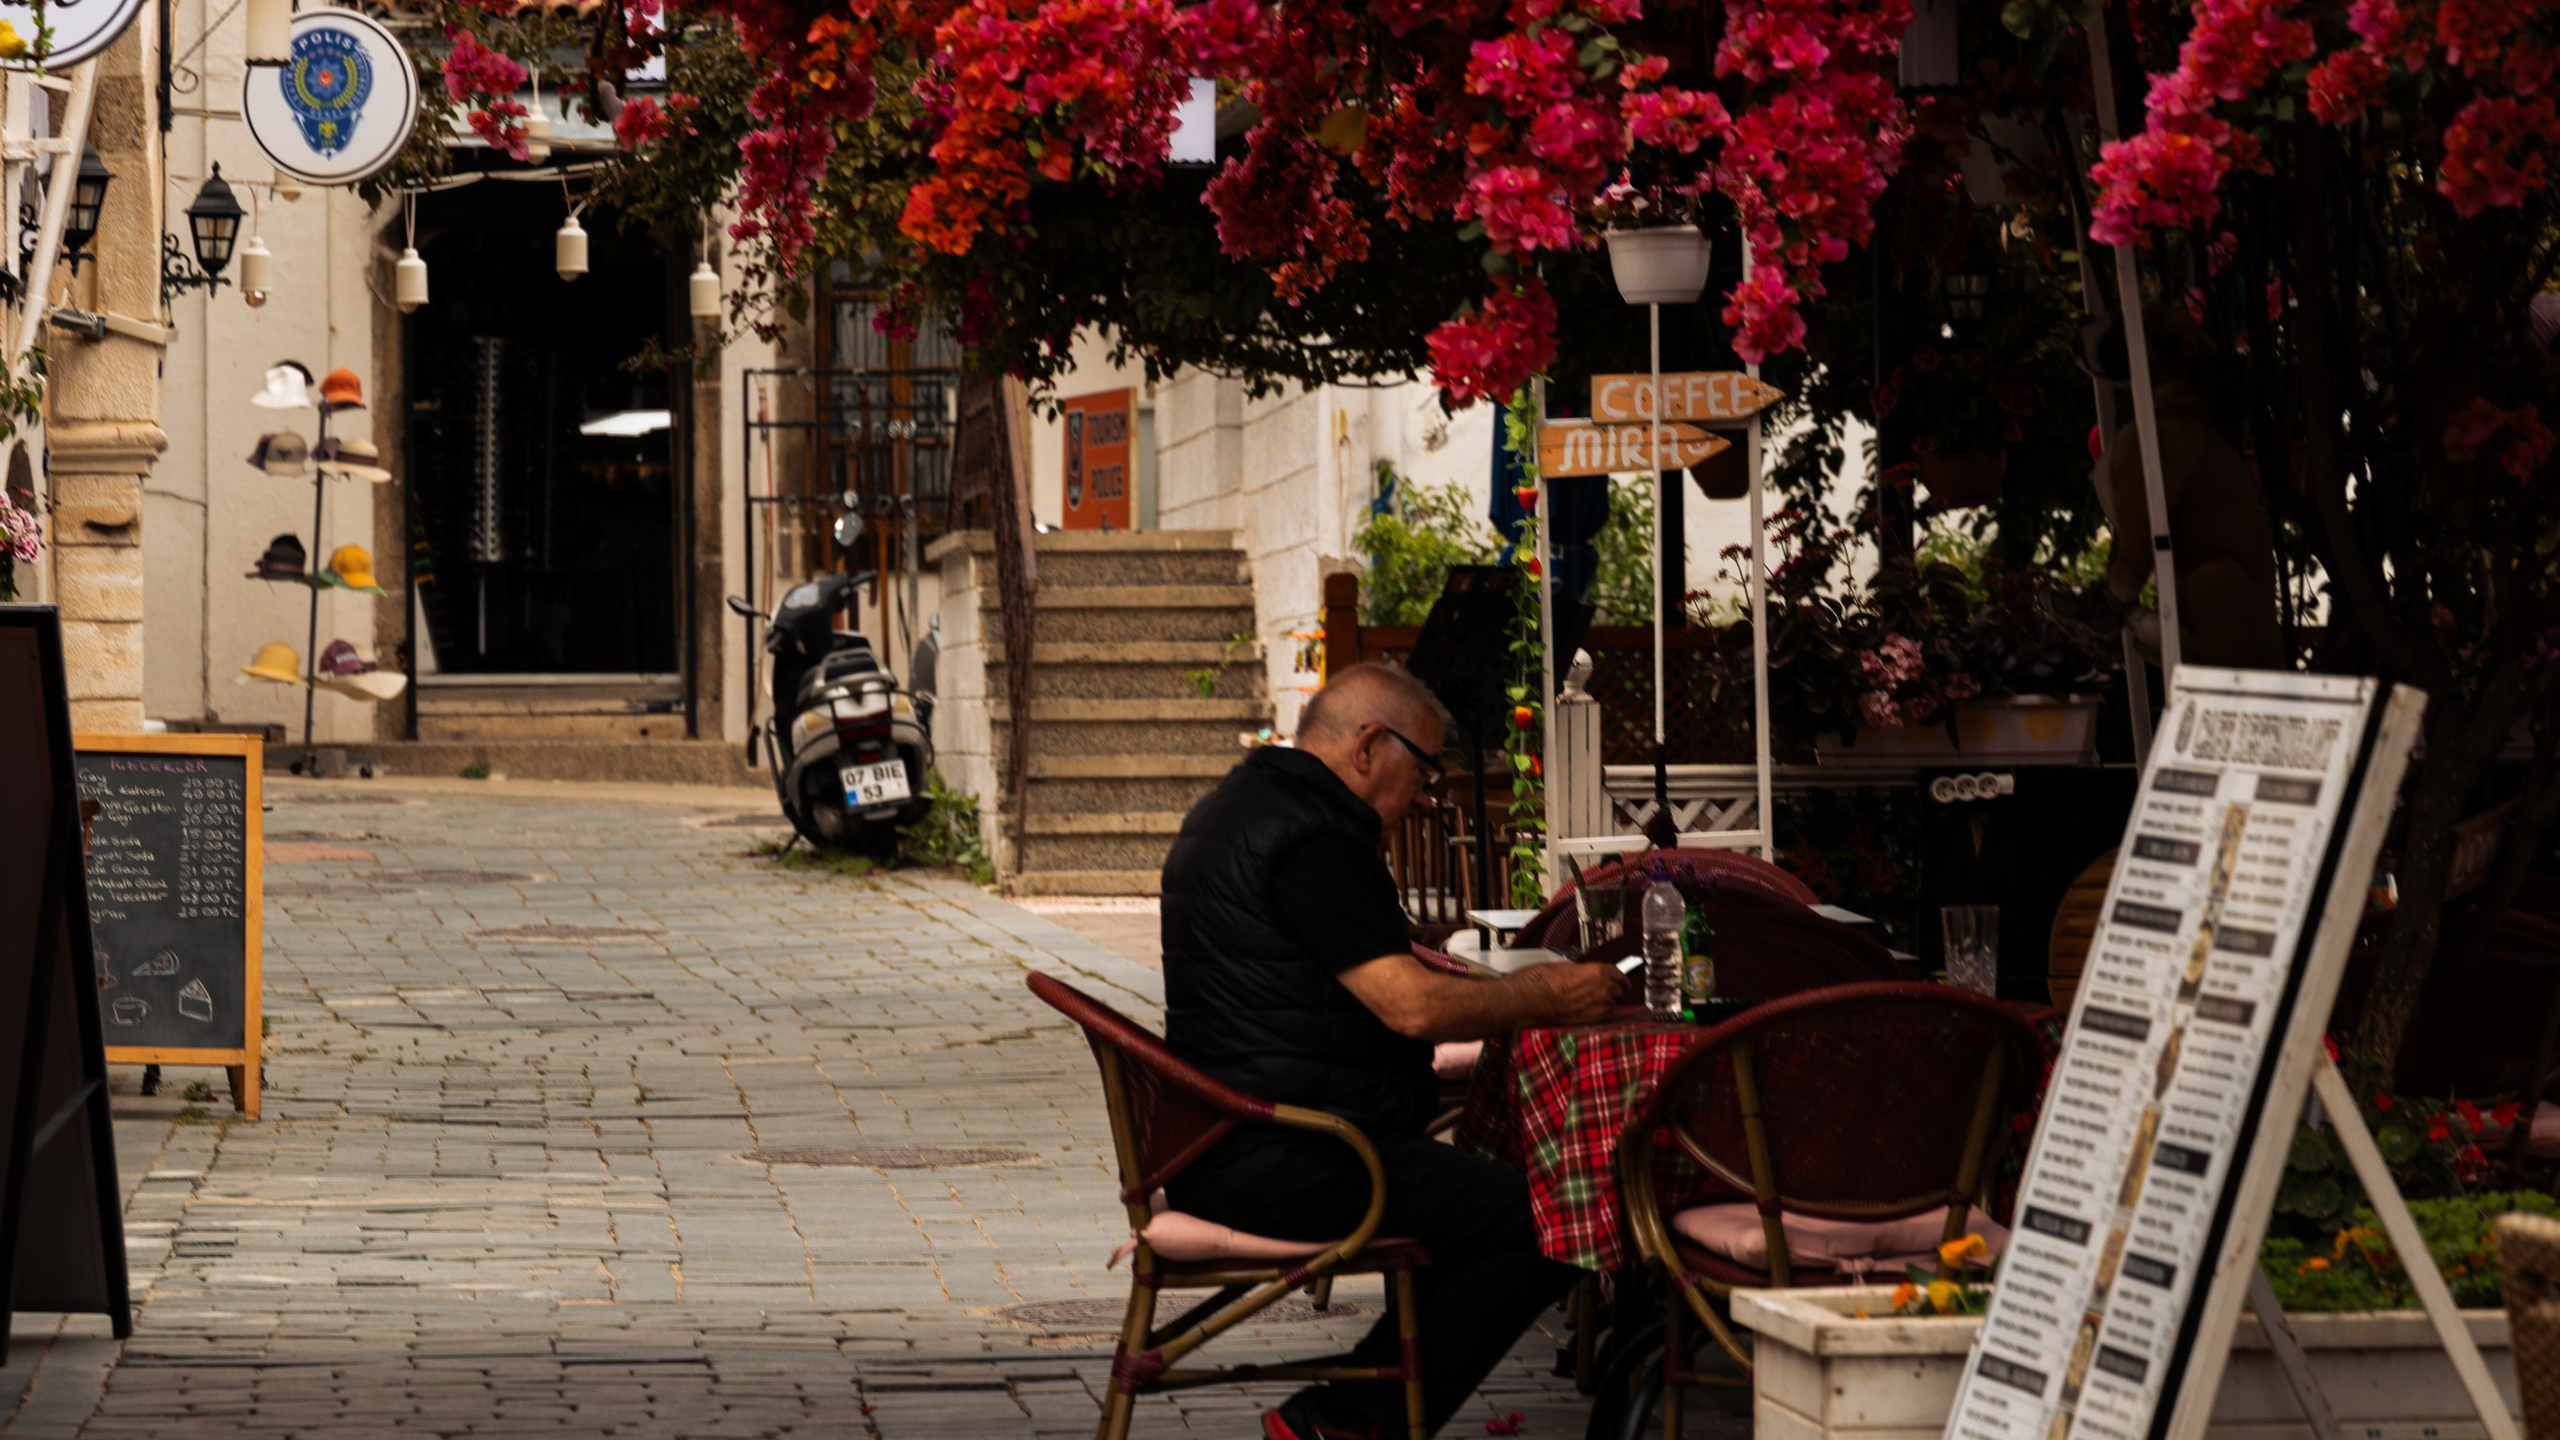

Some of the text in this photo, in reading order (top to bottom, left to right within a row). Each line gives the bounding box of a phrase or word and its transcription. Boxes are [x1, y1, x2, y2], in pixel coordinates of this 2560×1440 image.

[298, 31, 353, 52] POLİS
[1599, 373, 1755, 420] COFFEE
[1087, 409, 1127, 448] TOURISM
[1090, 464, 1124, 501] POLICE
[845, 769, 865, 785] 07
[862, 784, 884, 800] 53
